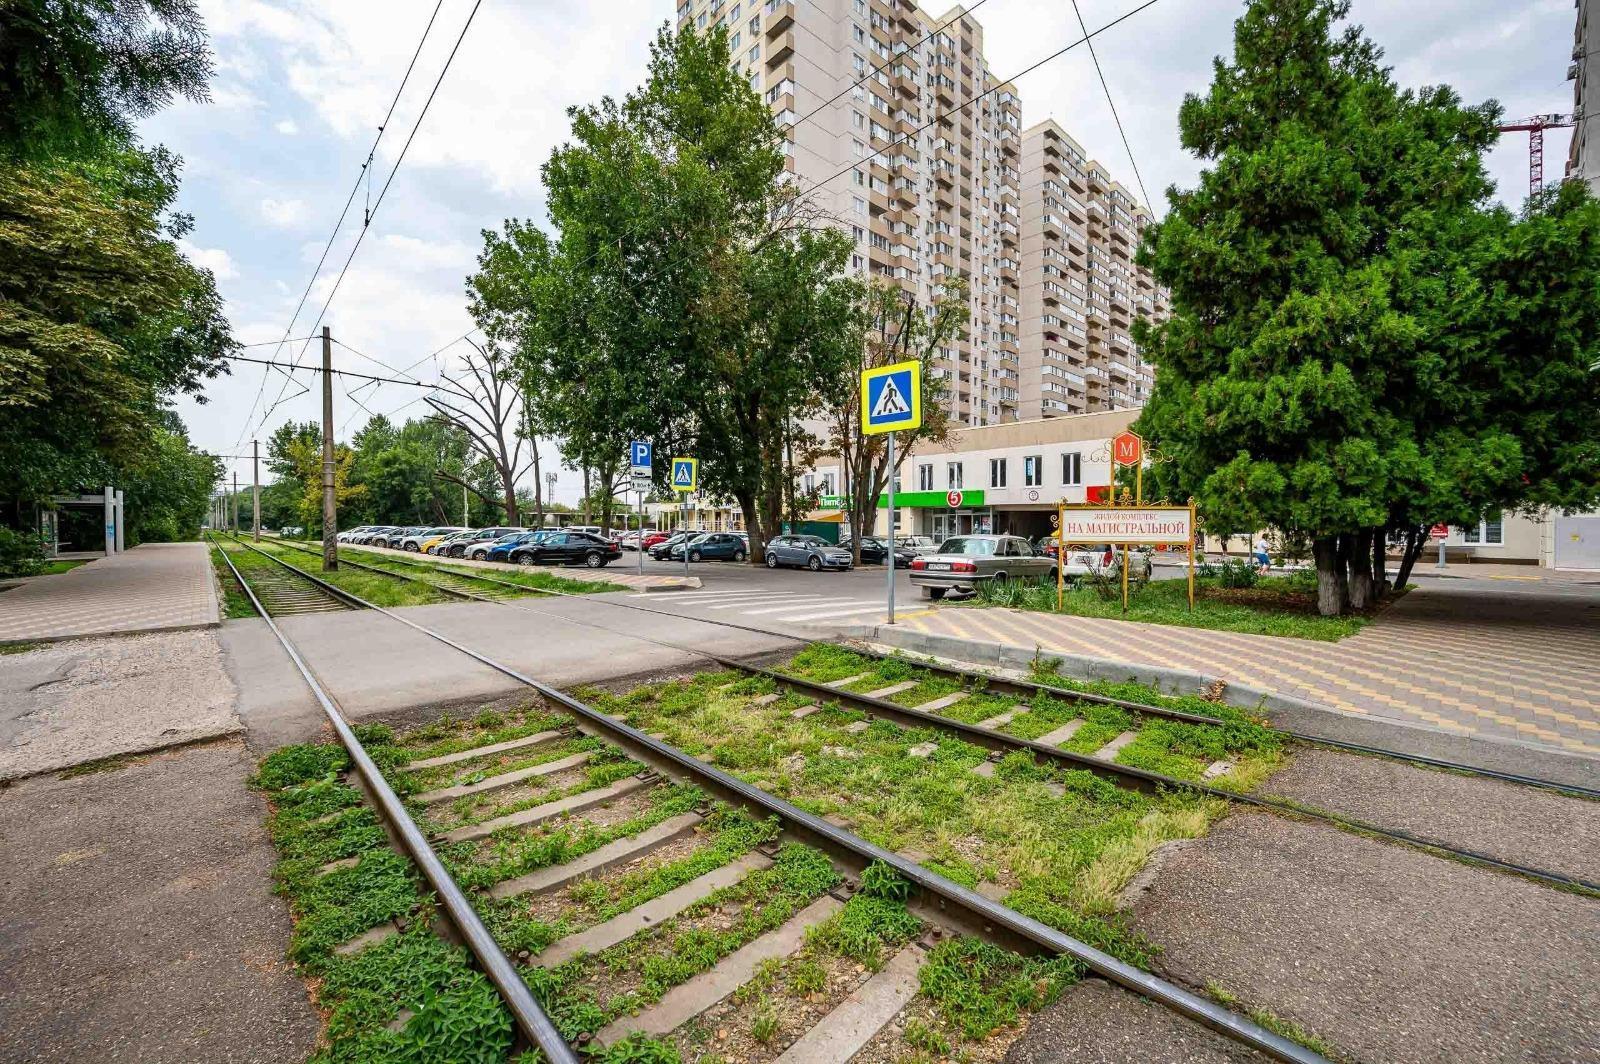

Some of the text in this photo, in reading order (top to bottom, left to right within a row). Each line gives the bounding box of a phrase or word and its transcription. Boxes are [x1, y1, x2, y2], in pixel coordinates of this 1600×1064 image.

[636, 445, 648, 464] P
[1120, 442, 1133, 456] М
[950, 490, 959, 505] 5
[1094, 512, 1119, 520] ЖИЛОЙ
[1068, 521, 1185, 534] НА МАГИСТРАЛЬНОЙ
